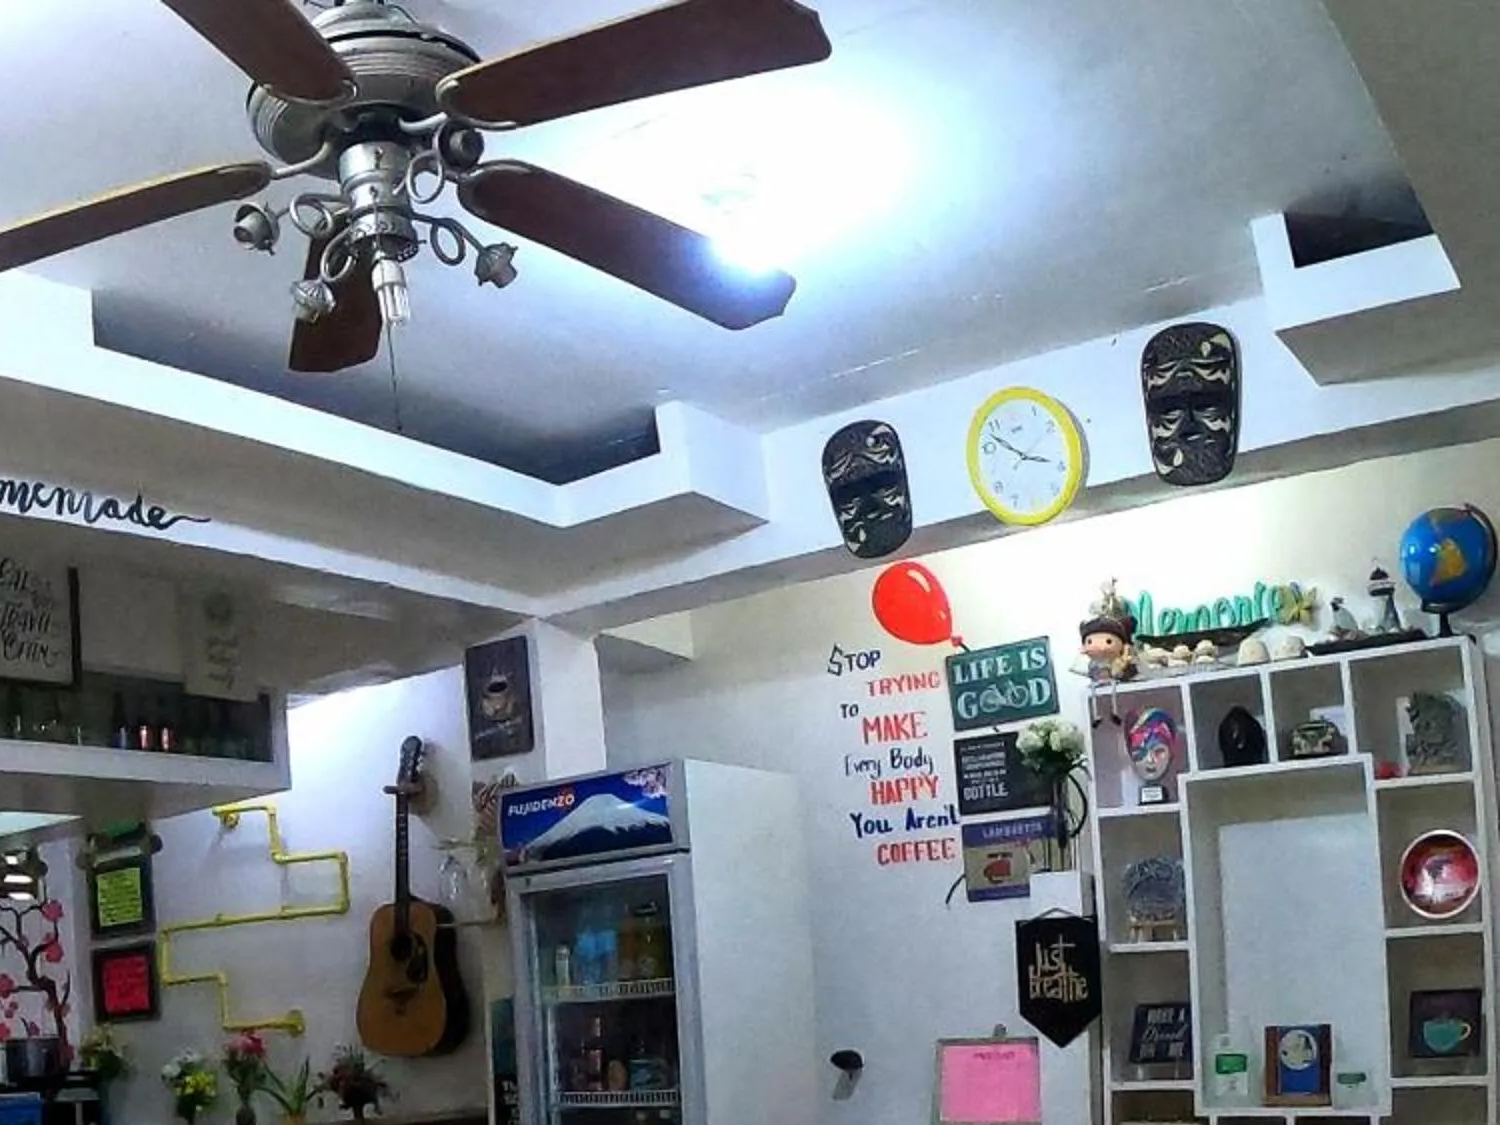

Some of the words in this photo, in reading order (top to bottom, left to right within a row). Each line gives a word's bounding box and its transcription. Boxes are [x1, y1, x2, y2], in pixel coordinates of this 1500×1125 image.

[827, 643, 881, 676] STOP
[953, 654, 1013, 685] LIFE
[1020, 646, 1048, 670] IS
[867, 671, 941, 697] TRYING
[956, 677, 1051, 719] GOOD
[840, 703, 859, 719] TO
[862, 711, 927, 745] MAKE
[890, 747, 933, 773] Body
[508, 793, 576, 817] FUJIDENZO
[869, 776, 939, 805] HAPPY
[850, 812, 892, 838] You
[905, 804, 960, 831] Aren't
[876, 838, 956, 866] COFFEE
[1033, 934, 1077, 975] Just
[1028, 963, 1089, 1003] breathe
